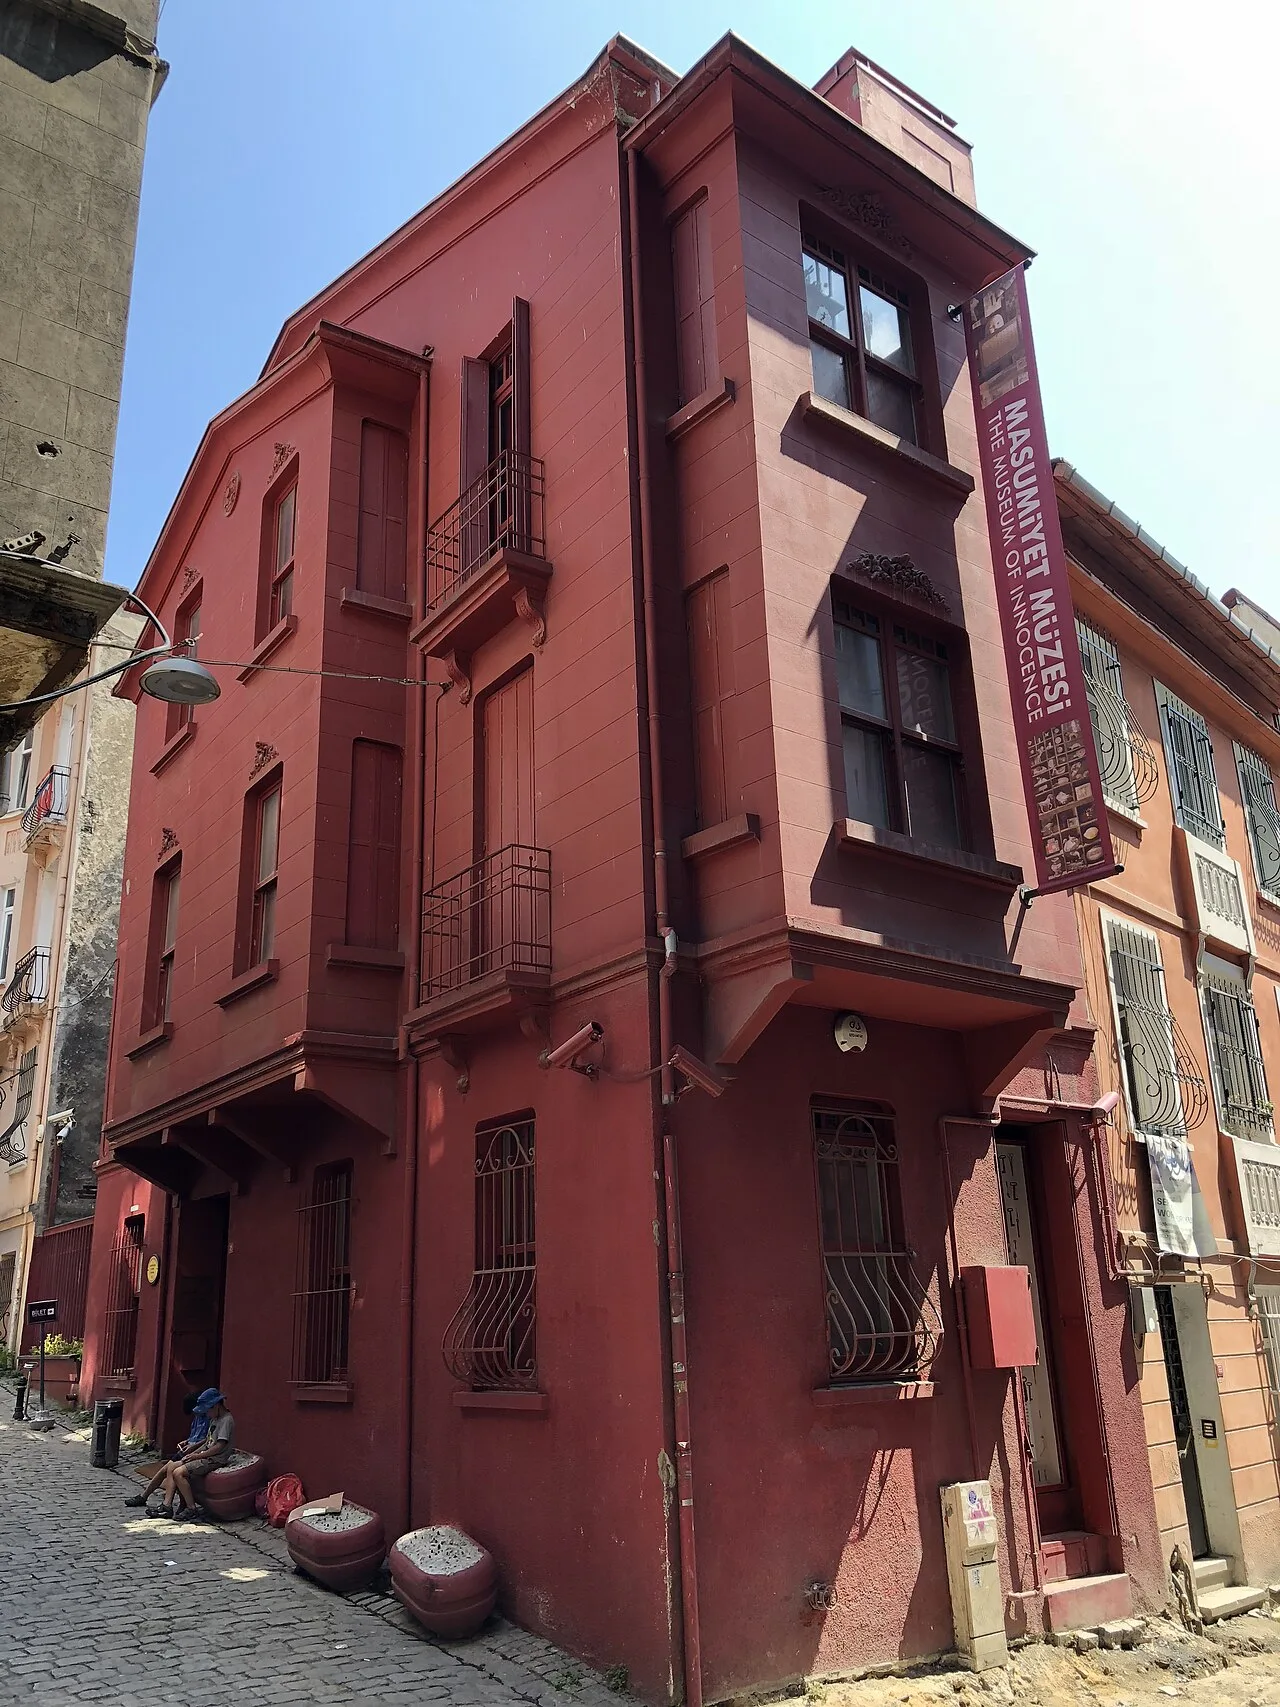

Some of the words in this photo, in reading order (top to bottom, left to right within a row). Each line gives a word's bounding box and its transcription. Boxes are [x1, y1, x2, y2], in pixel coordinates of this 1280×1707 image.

[988, 409, 1005, 453] THE
[992, 454, 1017, 547] MUSEUM
[1004, 397, 1051, 579] MASUMİYET
[1029, 588, 1071, 714] MÜZESİ
[1005, 549, 1022, 579] OF
[1010, 584, 1044, 724] INNOCENCE
